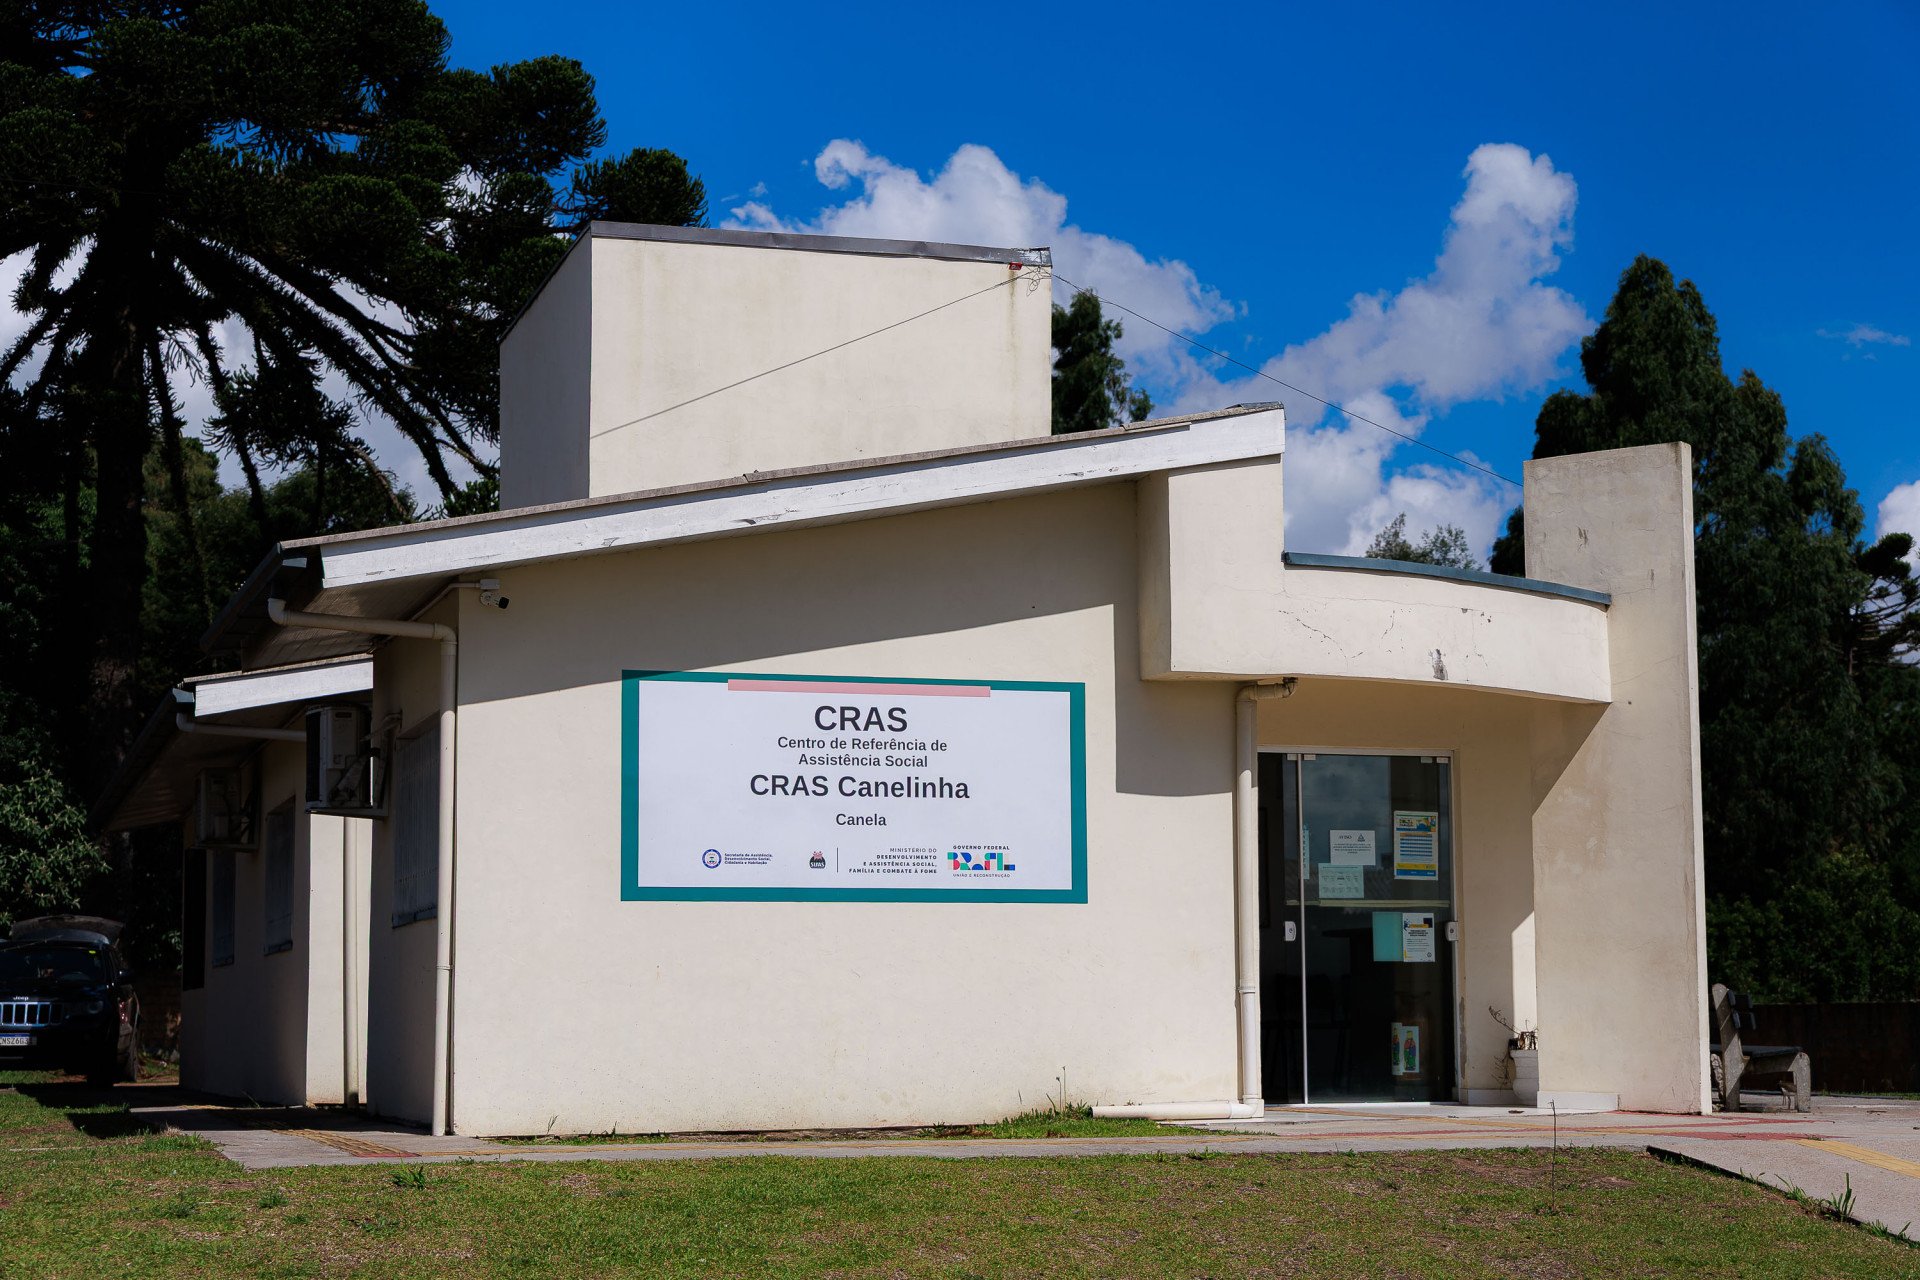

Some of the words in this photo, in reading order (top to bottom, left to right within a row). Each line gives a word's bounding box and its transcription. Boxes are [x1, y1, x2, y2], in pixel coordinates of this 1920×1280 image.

[815, 706, 907, 732] CRAS
[778, 737, 825, 748] Centro
[830, 738, 846, 749] de
[852, 738, 926, 750] Referência
[931, 740, 947, 751] de
[799, 754, 880, 766] Assistência
[886, 756, 927, 767] Social
[751, 775, 828, 796] CRAS
[839, 776, 969, 798] Canelinha
[836, 814, 886, 825] Canela
[947, 852, 1016, 870] BRASIL
